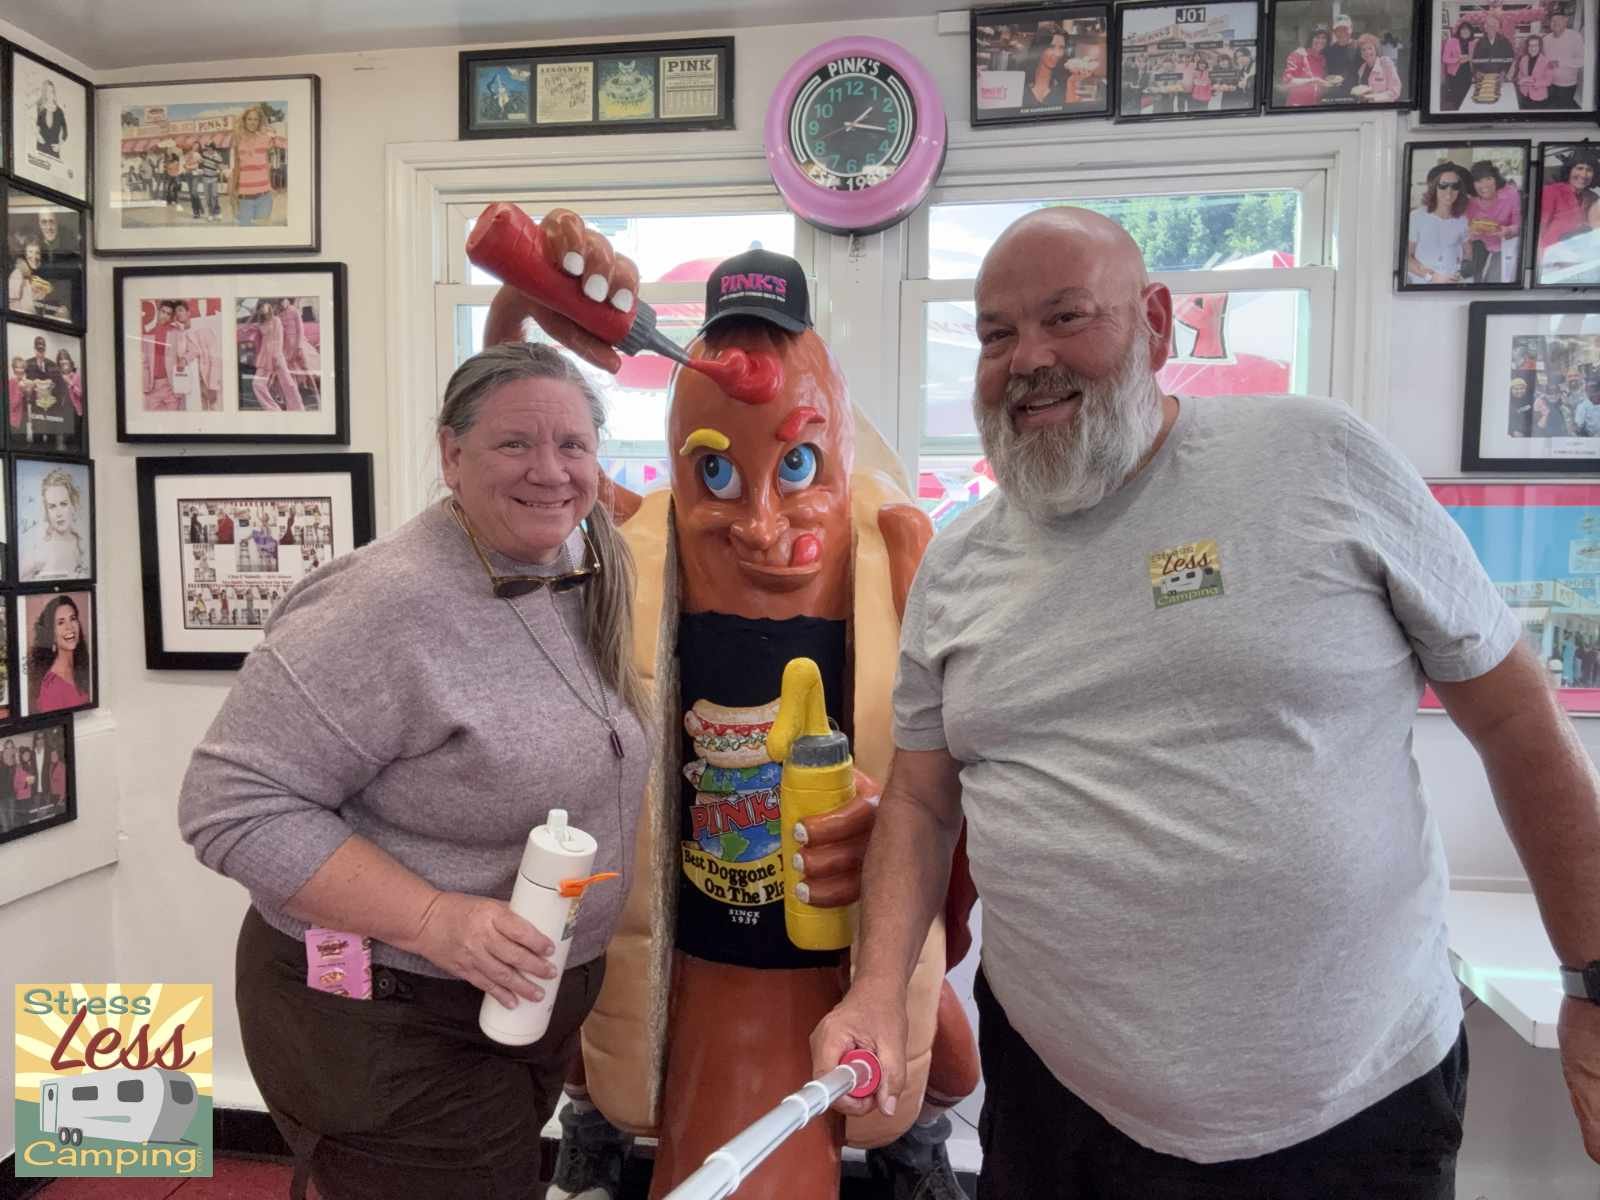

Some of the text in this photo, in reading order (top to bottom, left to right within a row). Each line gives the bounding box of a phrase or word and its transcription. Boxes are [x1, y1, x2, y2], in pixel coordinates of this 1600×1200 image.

[667, 60, 712, 73] PINK
[828, 58, 880, 77] PINK'S
[828, 88, 842, 102] 11
[845, 81, 864, 96] 12
[871, 87, 878, 100] 1
[815, 103, 832, 118] 10
[882, 98, 893, 112] 2
[808, 120, 819, 135] 9
[887, 118, 898, 133] 3
[815, 141, 826, 155] 8
[879, 140, 890, 154] 4
[831, 154, 840, 169] 7
[847, 159, 856, 174] 6
[866, 153, 876, 165] 5
[720, 273, 787, 295] PINK'S
[1162, 552, 1211, 576] Less
[691, 790, 782, 839] PINK
[684, 849, 706, 870] Best
[708, 855, 775, 887] Doggone
[705, 879, 726, 898] On
[727, 885, 760, 905] The
[729, 909, 760, 918] SINCE
[731, 916, 758, 926] 1939
